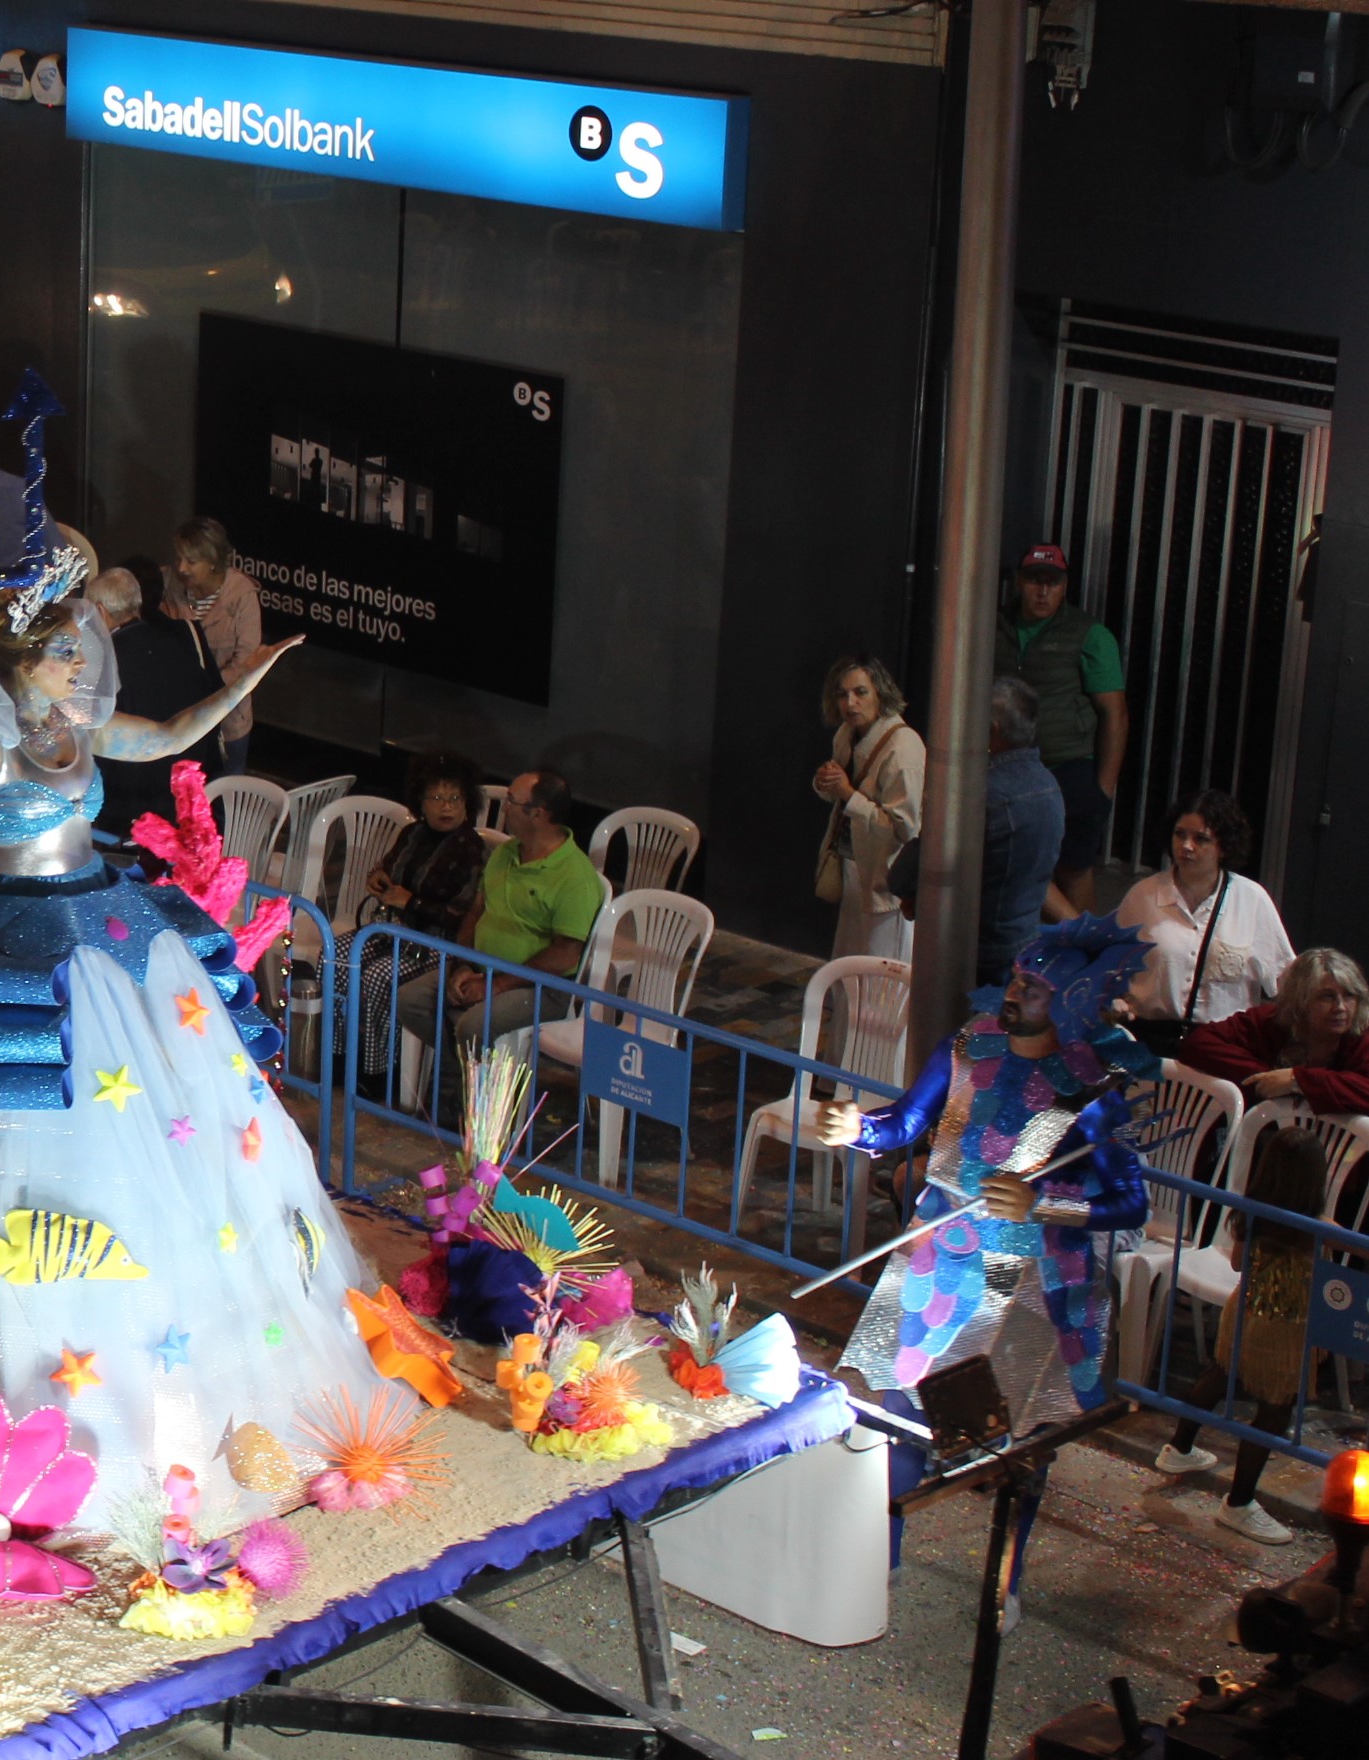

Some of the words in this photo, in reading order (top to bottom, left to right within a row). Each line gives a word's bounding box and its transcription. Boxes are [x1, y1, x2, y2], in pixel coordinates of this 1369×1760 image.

[101, 84, 376, 163] SabadellSolbank
[293, 565, 317, 591] de
[321, 571, 350, 599] las
[353, 583, 436, 621] mejores
[310, 601, 333, 624] es
[336, 606, 354, 629] el
[357, 609, 406, 643] tuyo.
